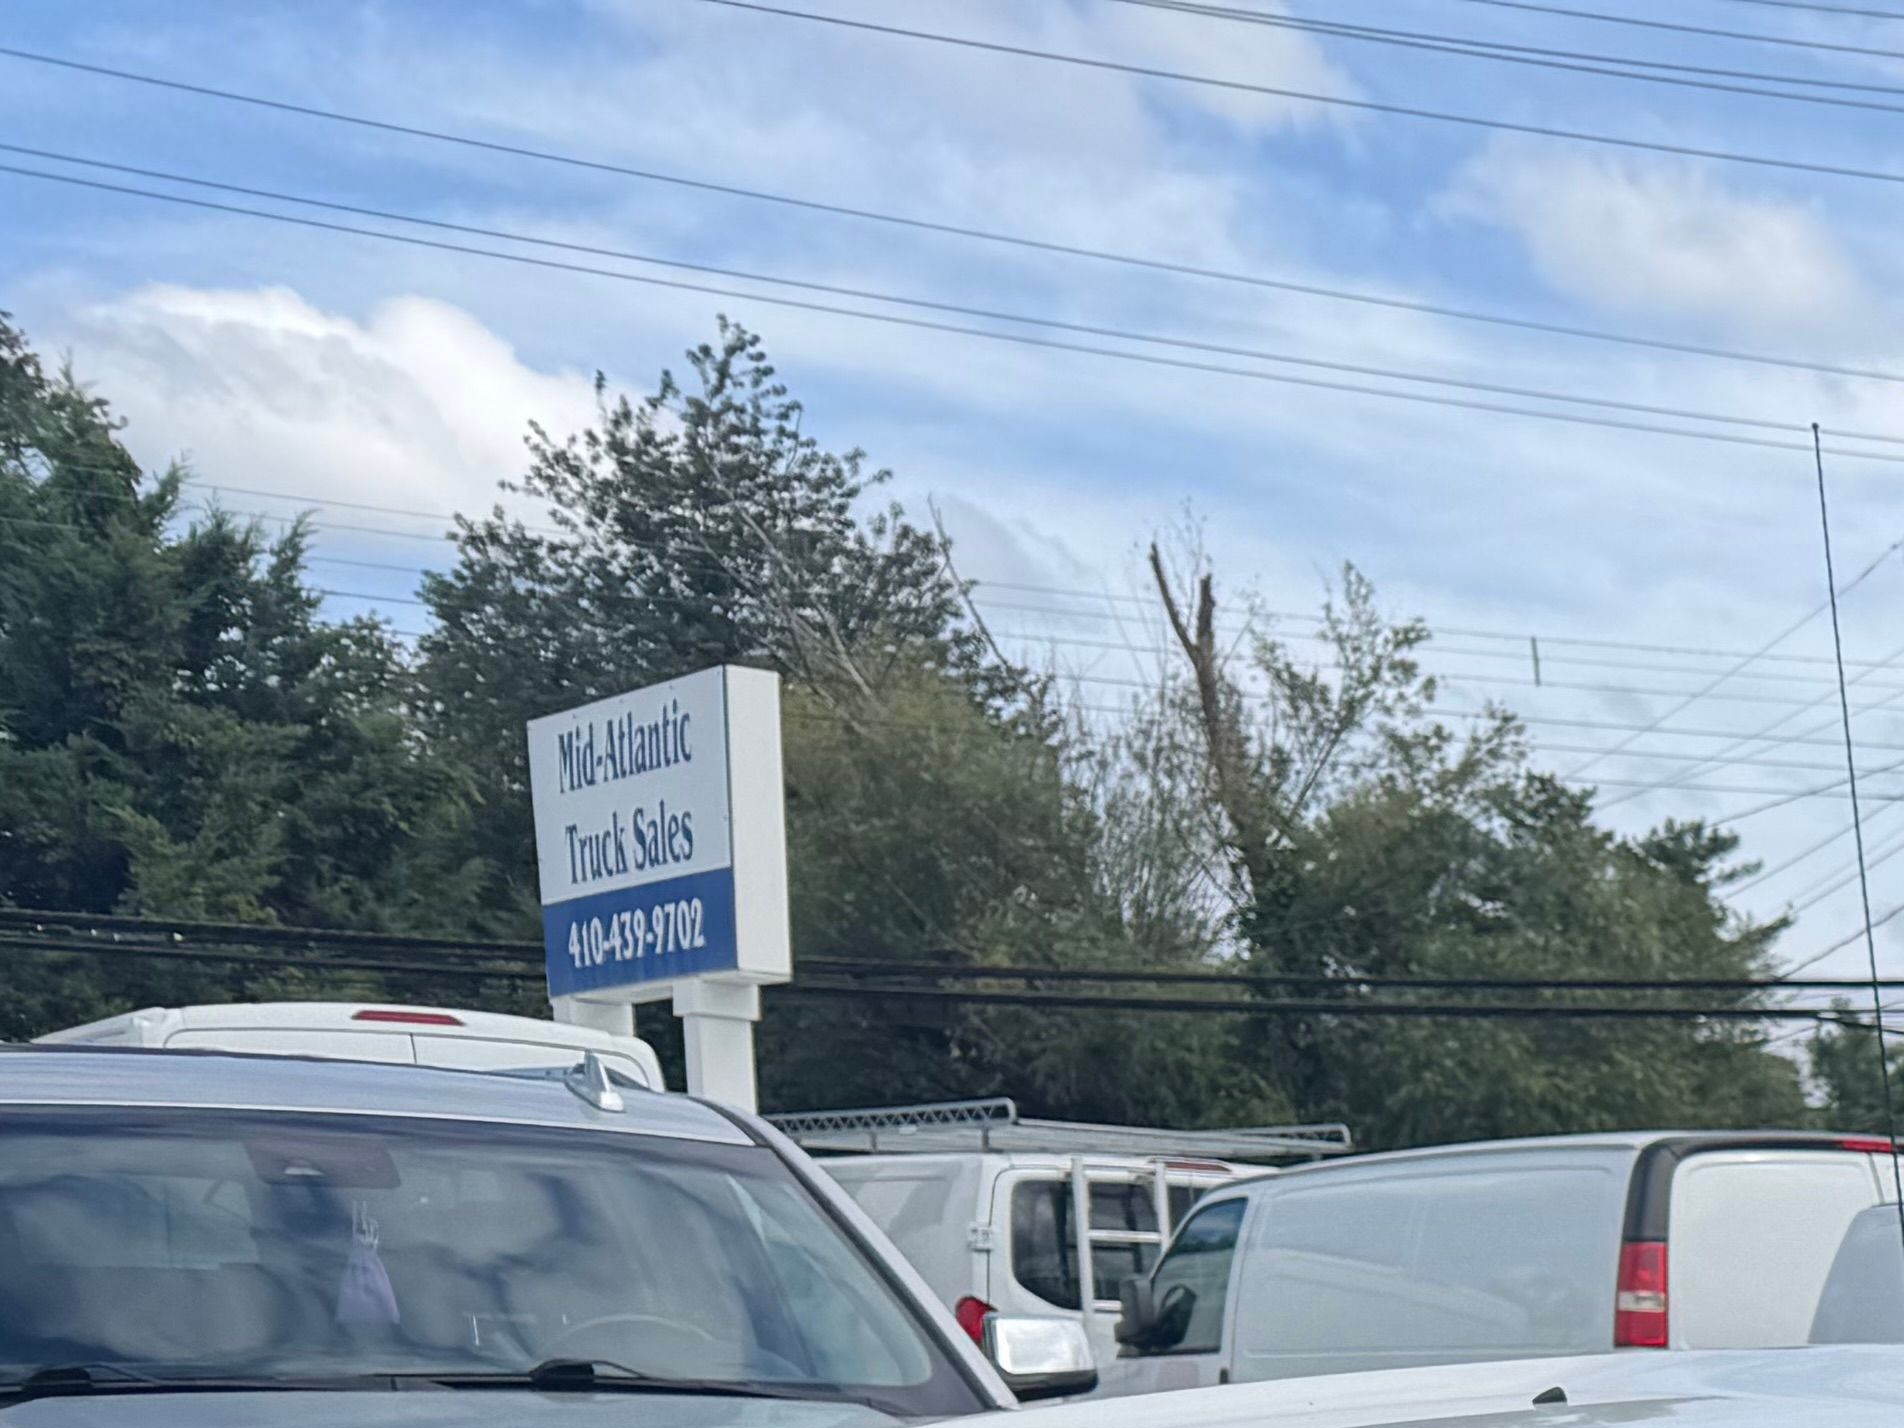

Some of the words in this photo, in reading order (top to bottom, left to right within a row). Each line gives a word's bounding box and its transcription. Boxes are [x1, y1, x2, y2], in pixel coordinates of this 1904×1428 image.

[557, 697, 693, 794] Mid-Atlantic
[565, 811, 627, 884] Truck
[632, 799, 694, 870] Sales
[567, 897, 705, 968] 410-439-9702
